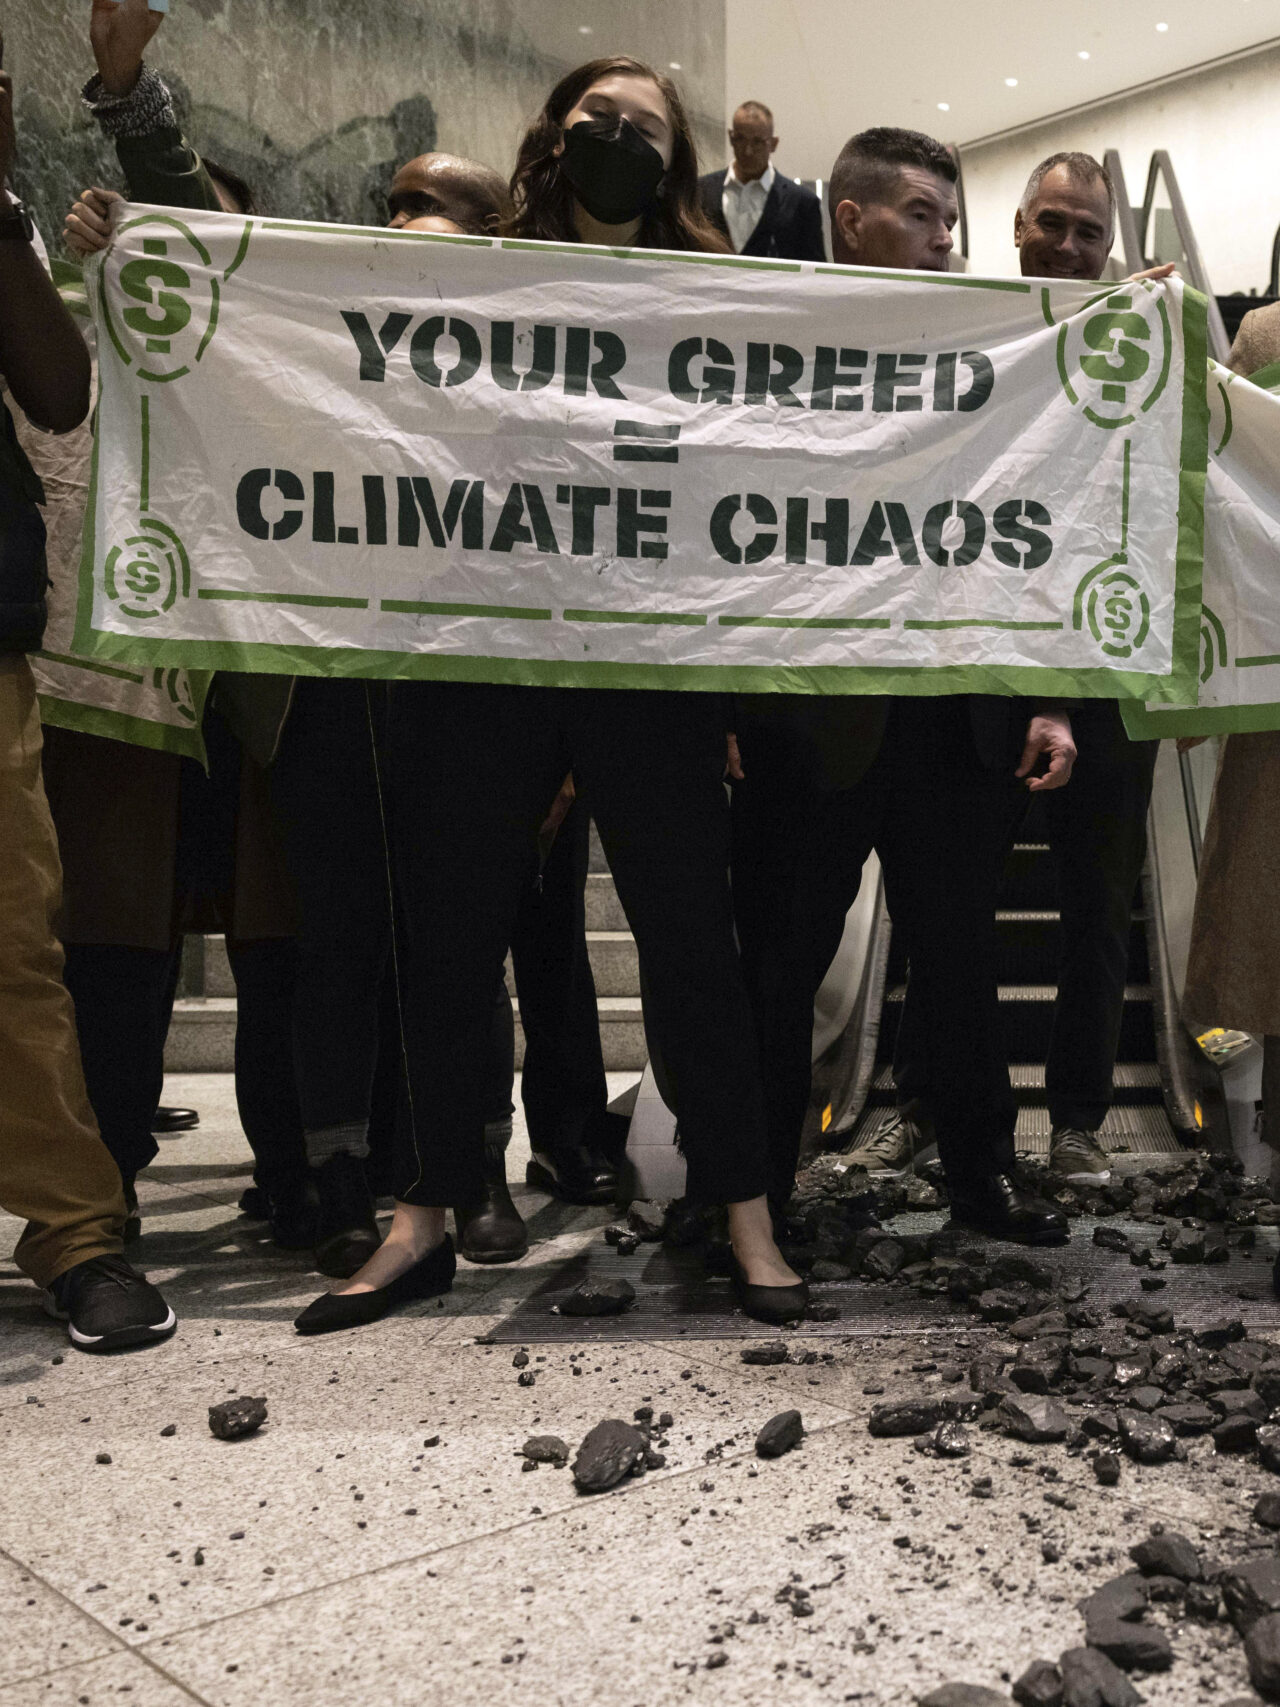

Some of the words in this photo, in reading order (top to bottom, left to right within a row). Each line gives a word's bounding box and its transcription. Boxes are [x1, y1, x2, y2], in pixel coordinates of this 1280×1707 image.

[339, 310, 629, 401] YOUR
[668, 336, 995, 413] GREED
[236, 467, 672, 560] CLIMATE
[709, 492, 1055, 568] CHAOS
